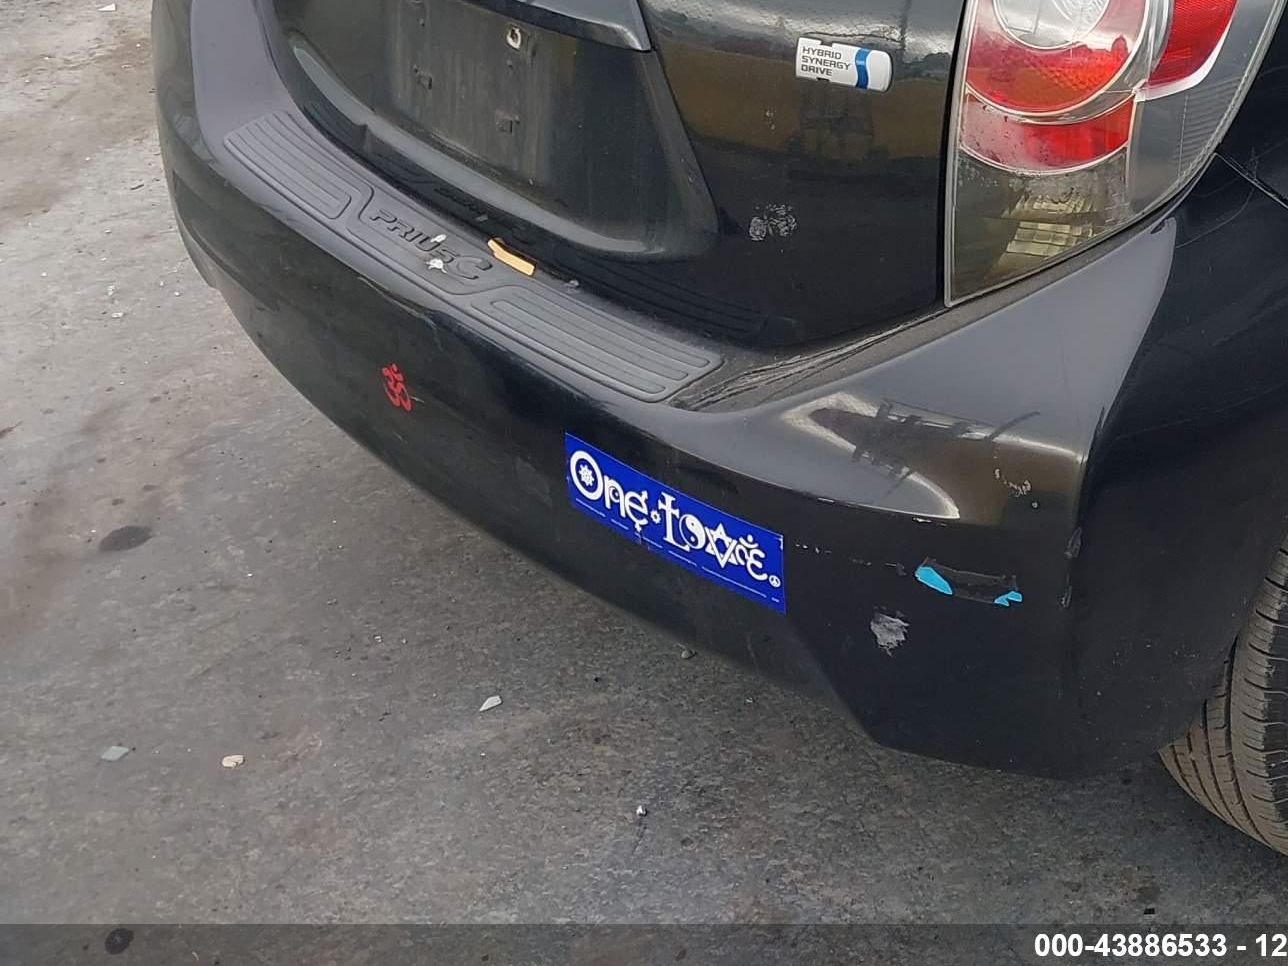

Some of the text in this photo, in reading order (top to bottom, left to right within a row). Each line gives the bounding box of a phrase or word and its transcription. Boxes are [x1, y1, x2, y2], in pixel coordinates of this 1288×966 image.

[801, 46, 842, 60] HYBRID
[801, 55, 851, 71] SYNERGY
[801, 63, 833, 76] DRIVE
